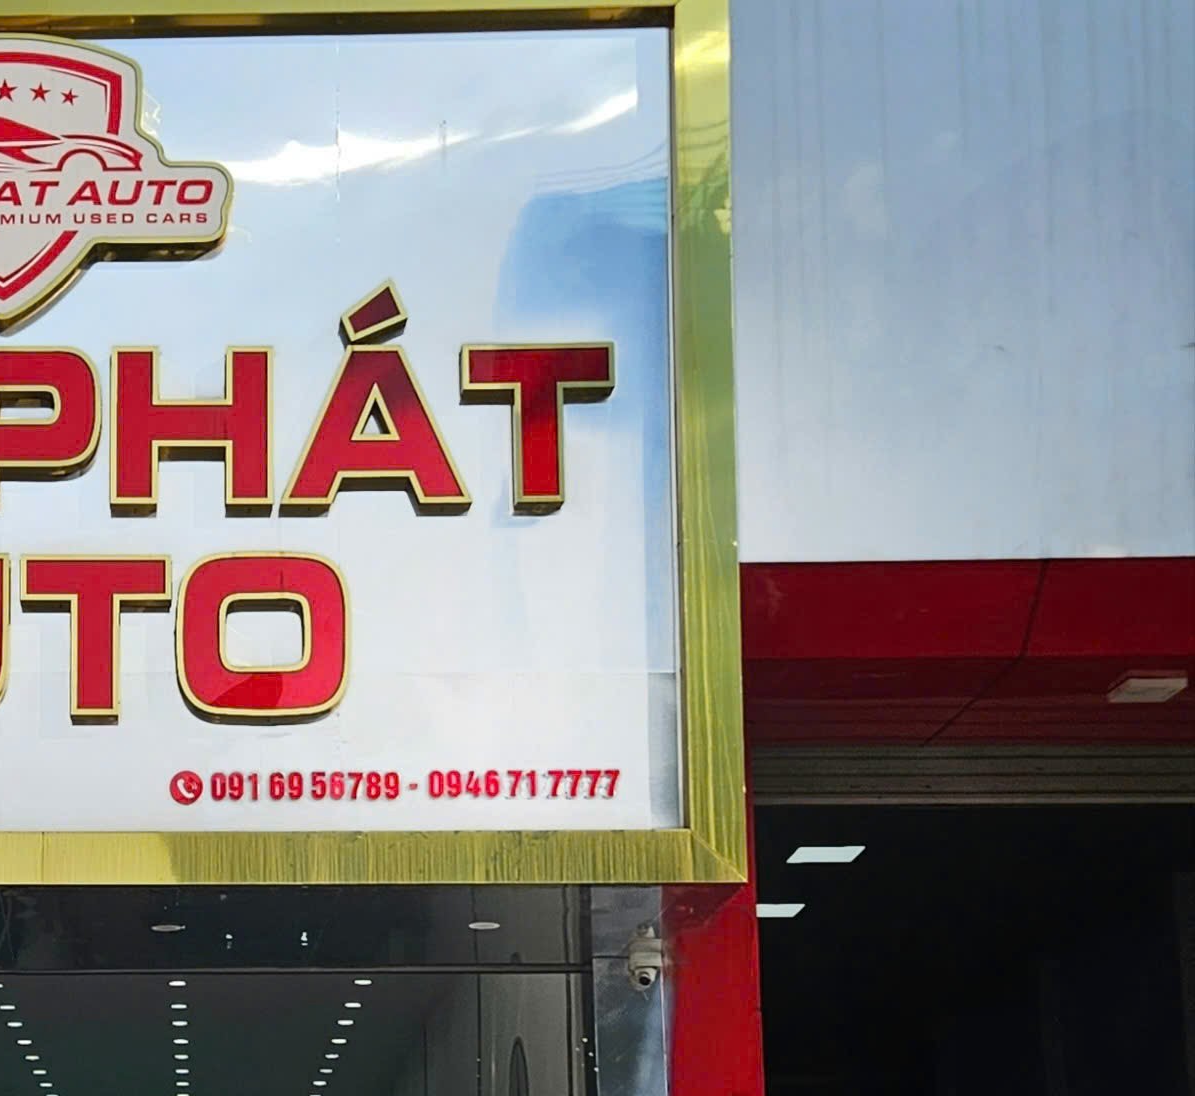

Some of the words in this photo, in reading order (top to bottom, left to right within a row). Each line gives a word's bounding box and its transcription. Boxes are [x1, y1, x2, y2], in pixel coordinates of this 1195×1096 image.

[67, 179, 214, 207] AUTO
[74, 213, 134, 225] USED
[146, 212, 209, 224] CARS
[210, 770, 260, 801] 091
[268, 770, 304, 801] 69
[310, 770, 401, 801] 56789
[428, 768, 502, 800] 0946
[508, 769, 538, 798] 71
[548, 769, 621, 799] 7777
